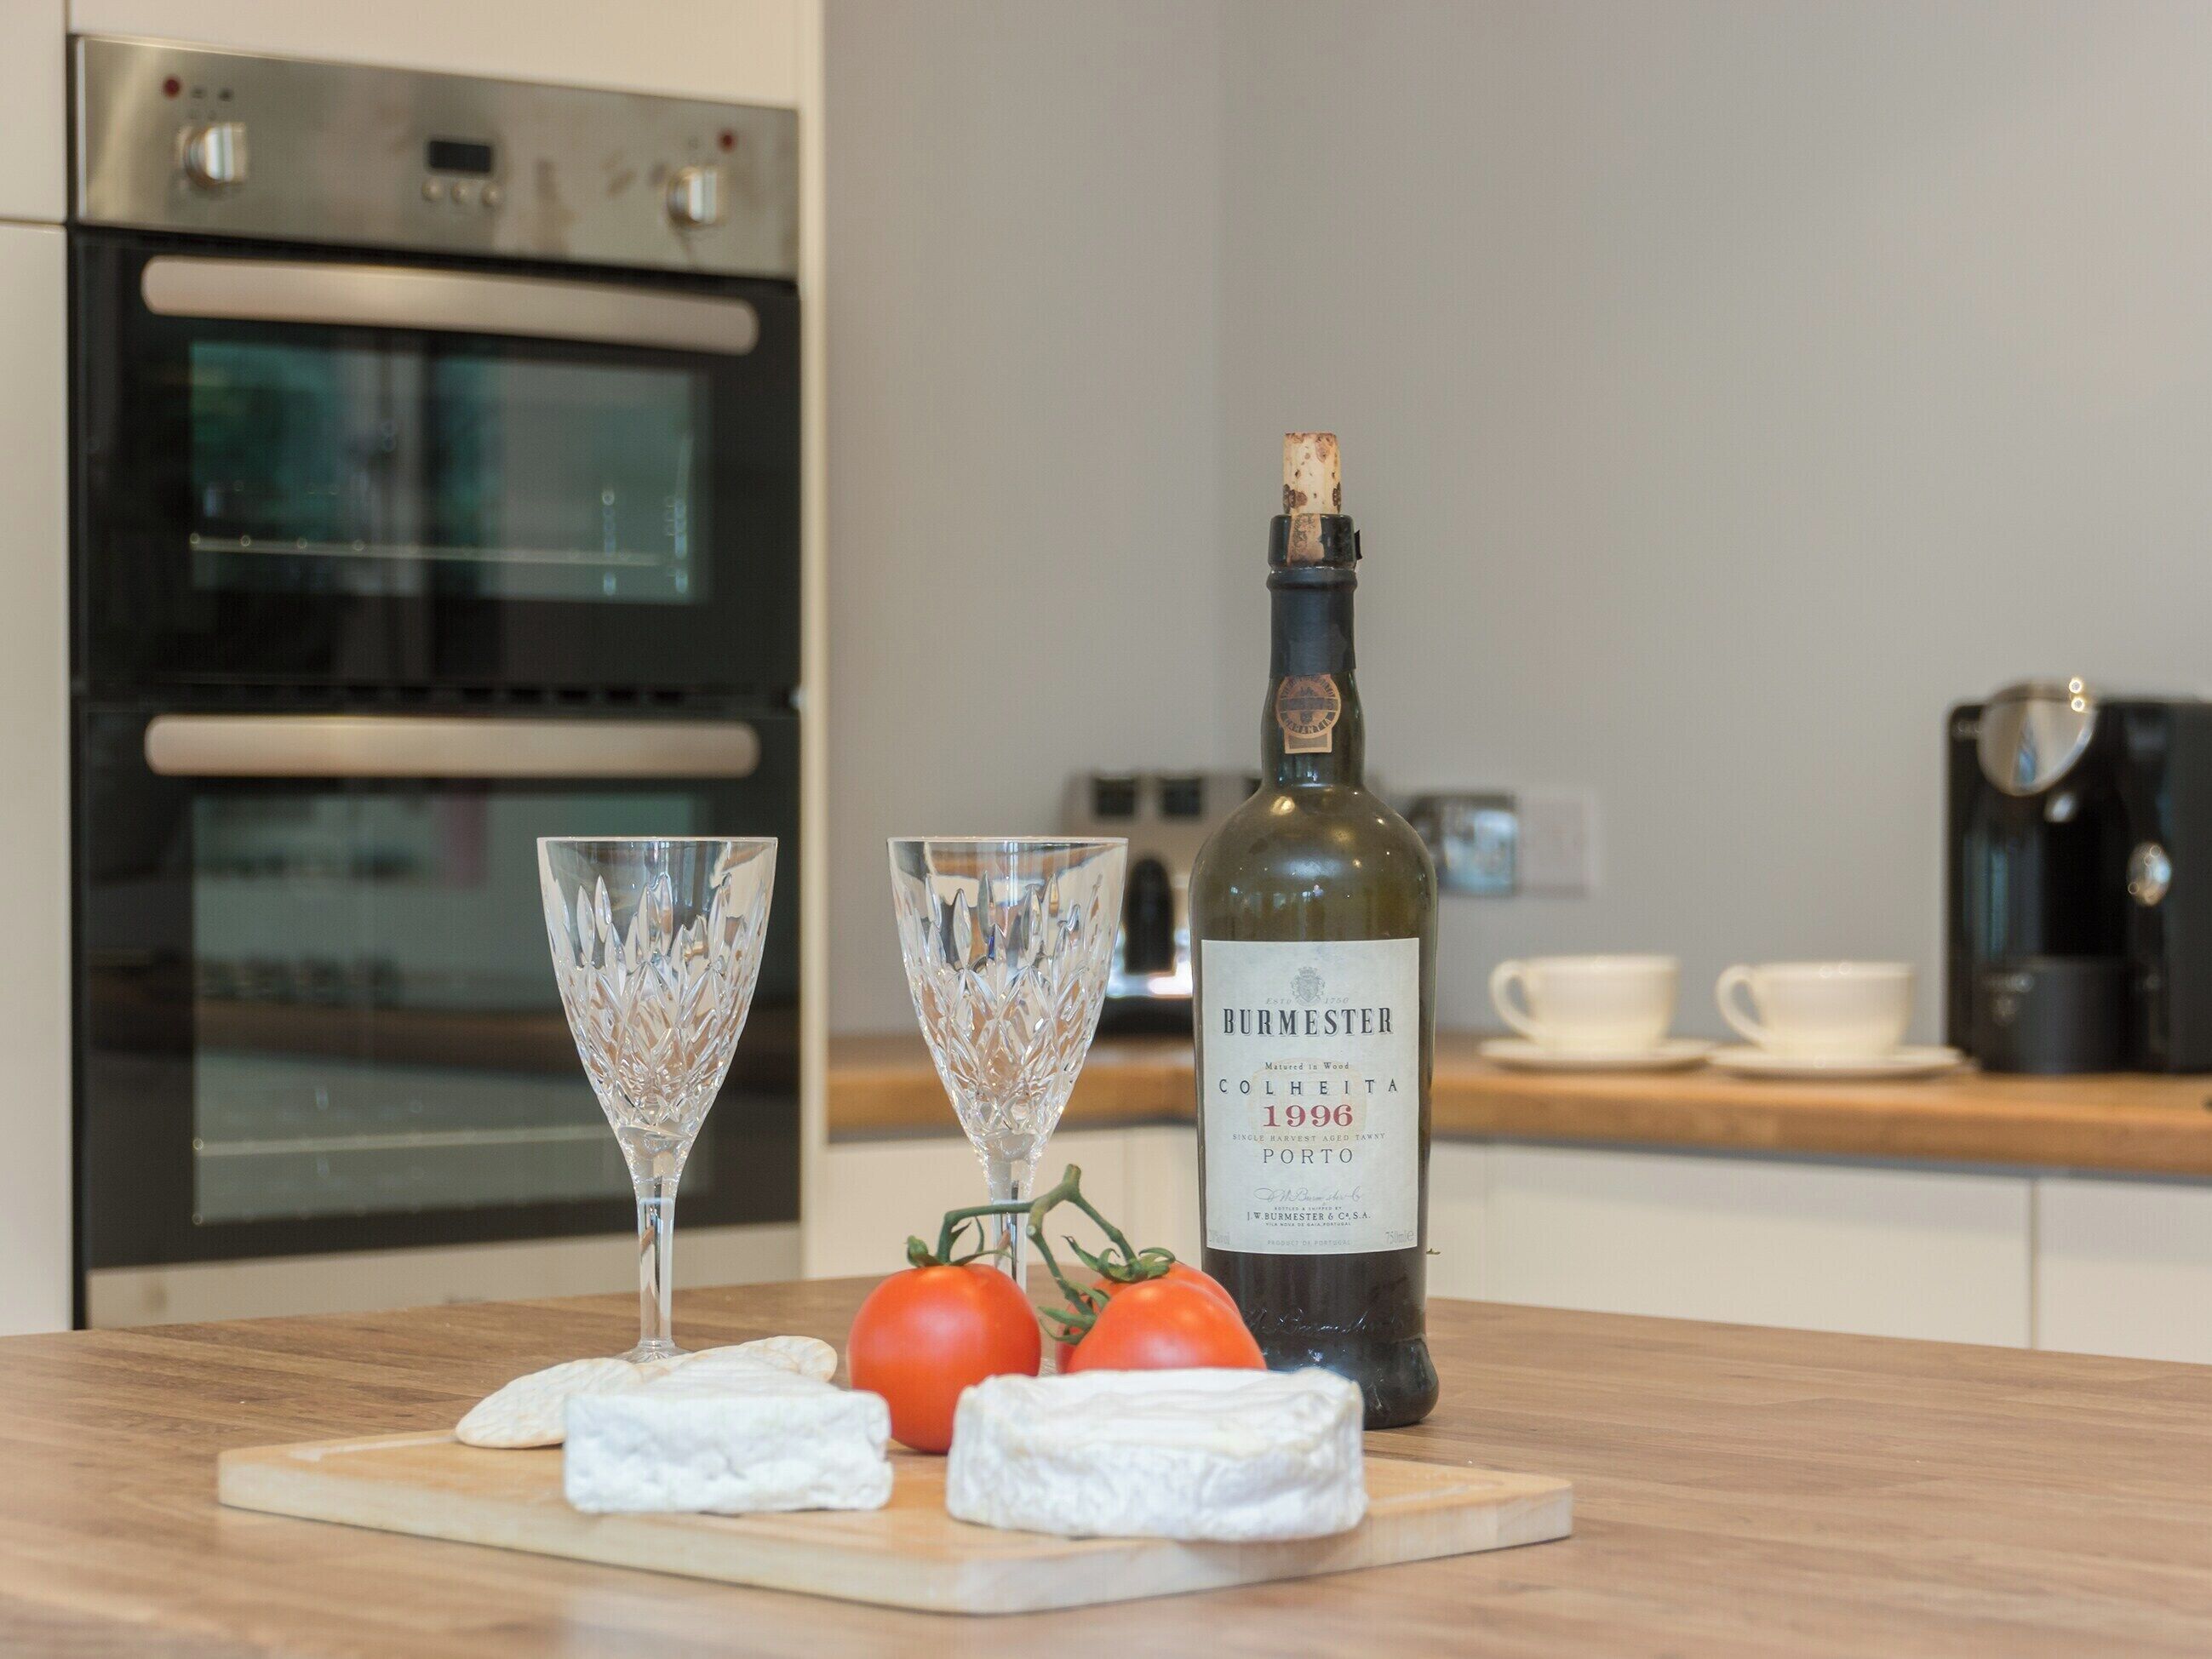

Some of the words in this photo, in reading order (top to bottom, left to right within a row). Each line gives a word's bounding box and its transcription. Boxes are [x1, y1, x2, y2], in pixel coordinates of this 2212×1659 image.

[1223, 1007, 1394, 1038] BURMESTER
[1265, 1061, 1304, 1070] Matured
[1323, 1061, 1350, 1070] Wood
[1218, 1078, 1398, 1095] COLHEITA
[1263, 1104, 1354, 1127] 1996
[1232, 1133, 1264, 1141] SINGLE
[1355, 1132, 1386, 1141] TAWNY
[1263, 1147, 1353, 1164] PORTO
[1327, 1212, 1334, 1221] &
